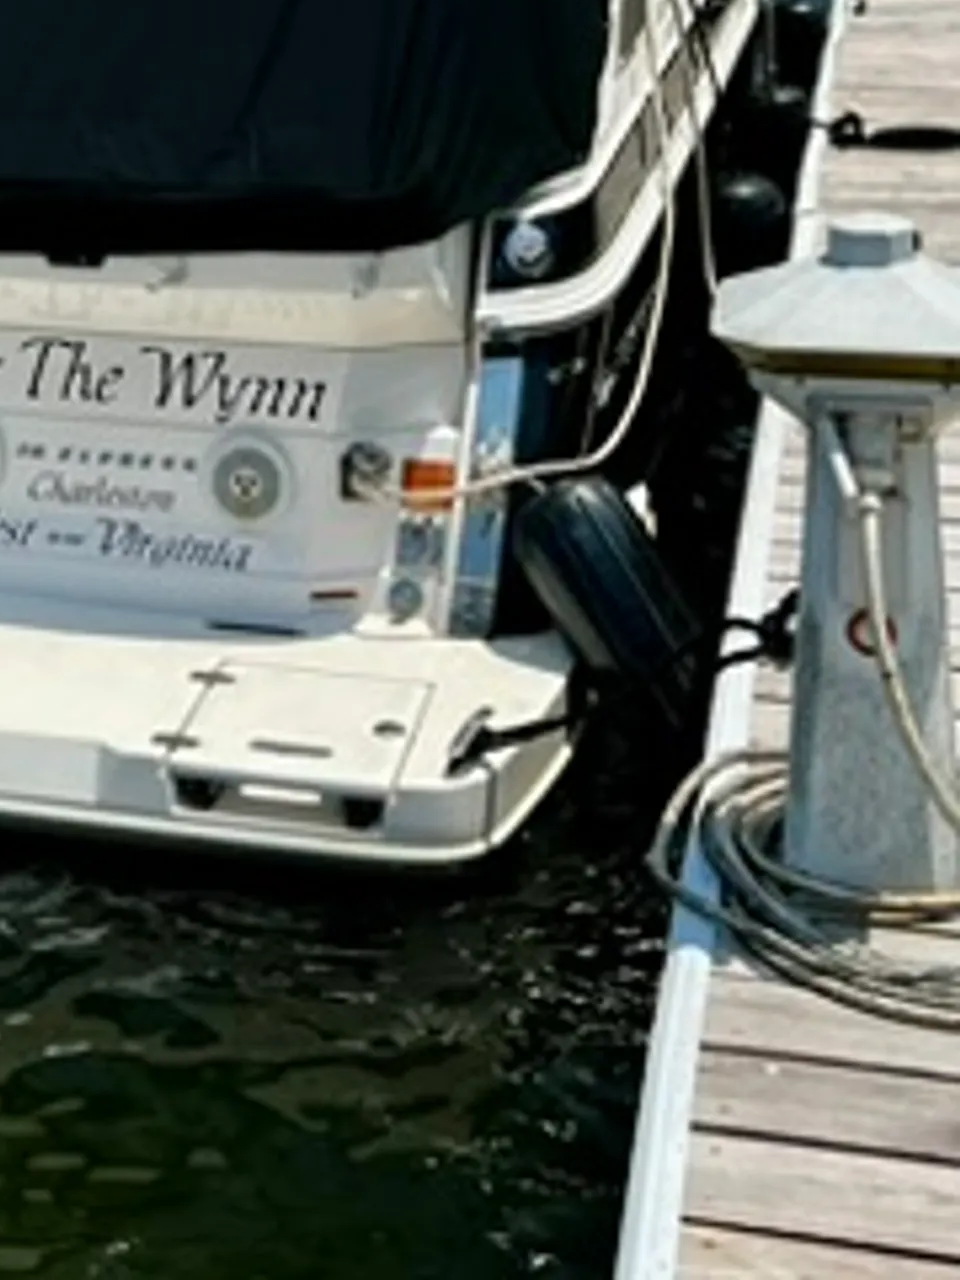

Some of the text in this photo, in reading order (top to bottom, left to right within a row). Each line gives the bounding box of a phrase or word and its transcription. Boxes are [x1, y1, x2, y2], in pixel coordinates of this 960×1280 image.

[21, 335, 125, 404] The
[140, 345, 328, 423] Wynn
[95, 517, 253, 572] Virginia
